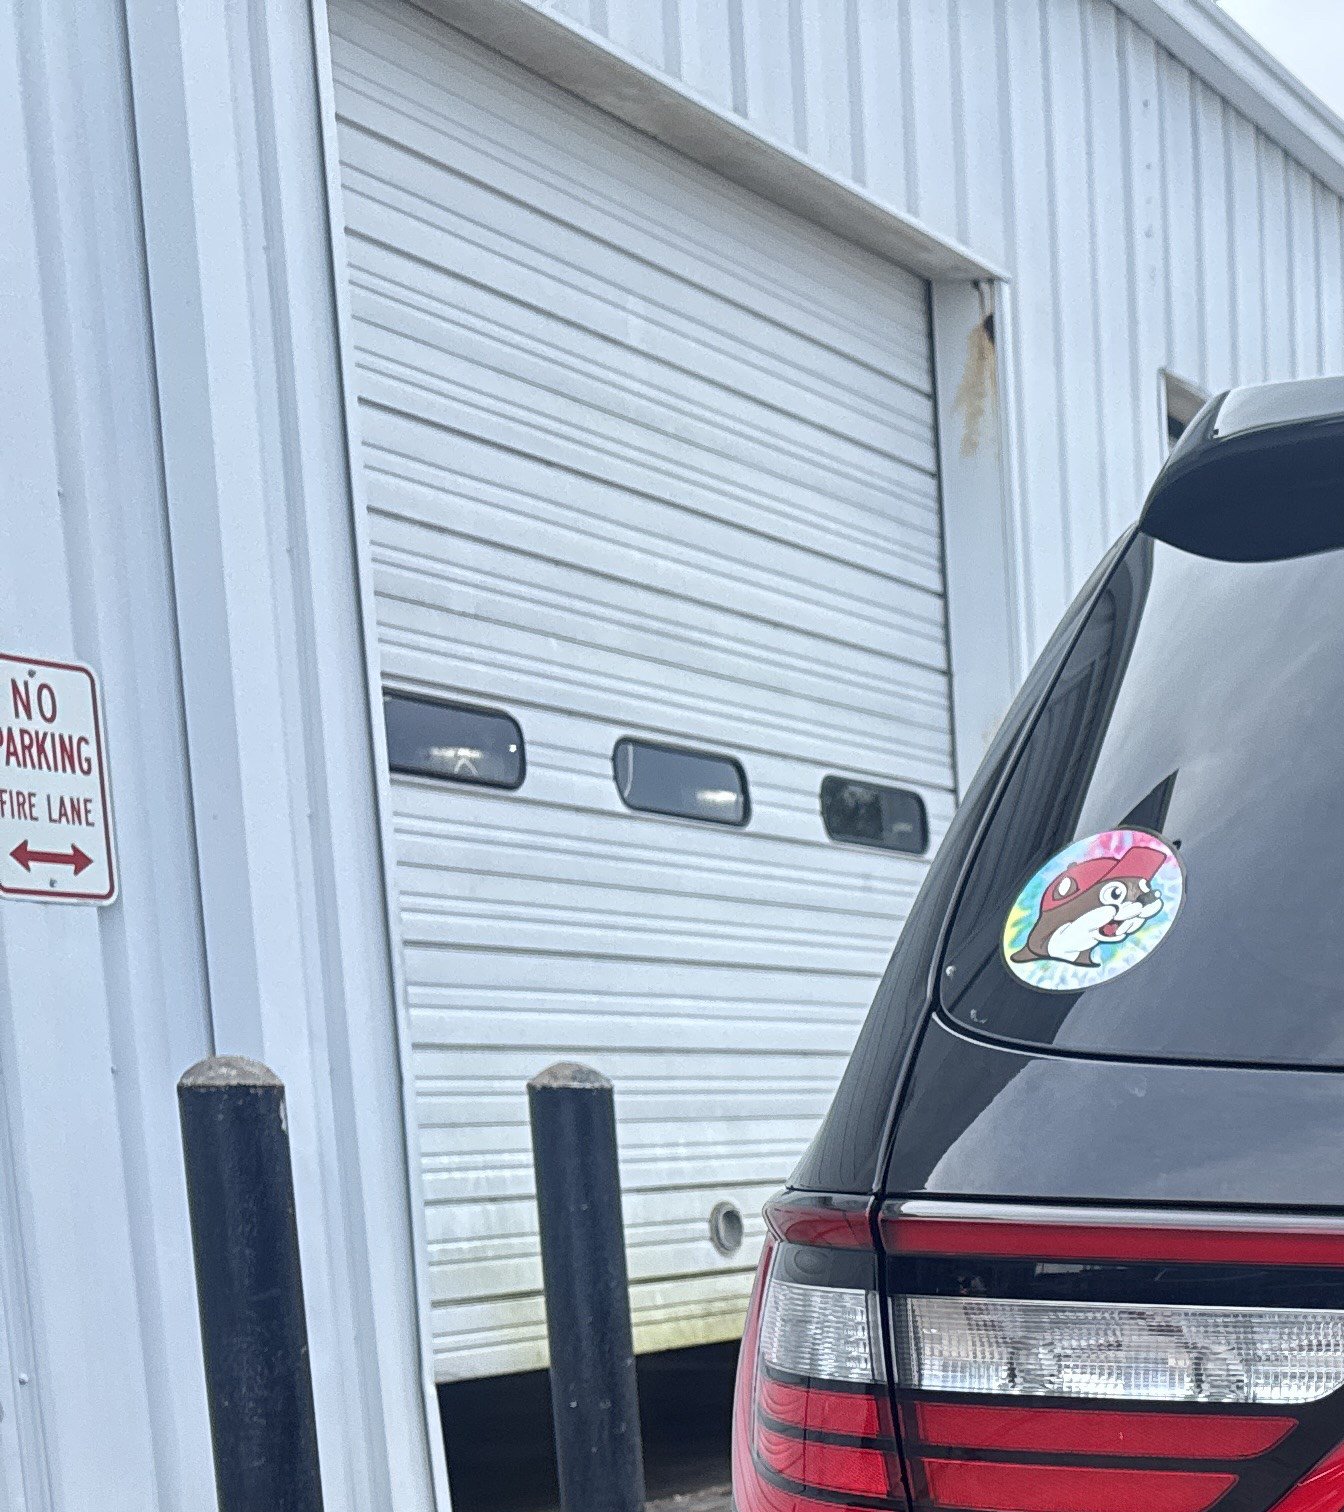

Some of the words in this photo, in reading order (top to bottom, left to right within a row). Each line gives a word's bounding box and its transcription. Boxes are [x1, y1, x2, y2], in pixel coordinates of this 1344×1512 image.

[11, 678, 58, 725] NO
[0, 726, 93, 777] ARKING
[46, 794, 95, 828] LANE
